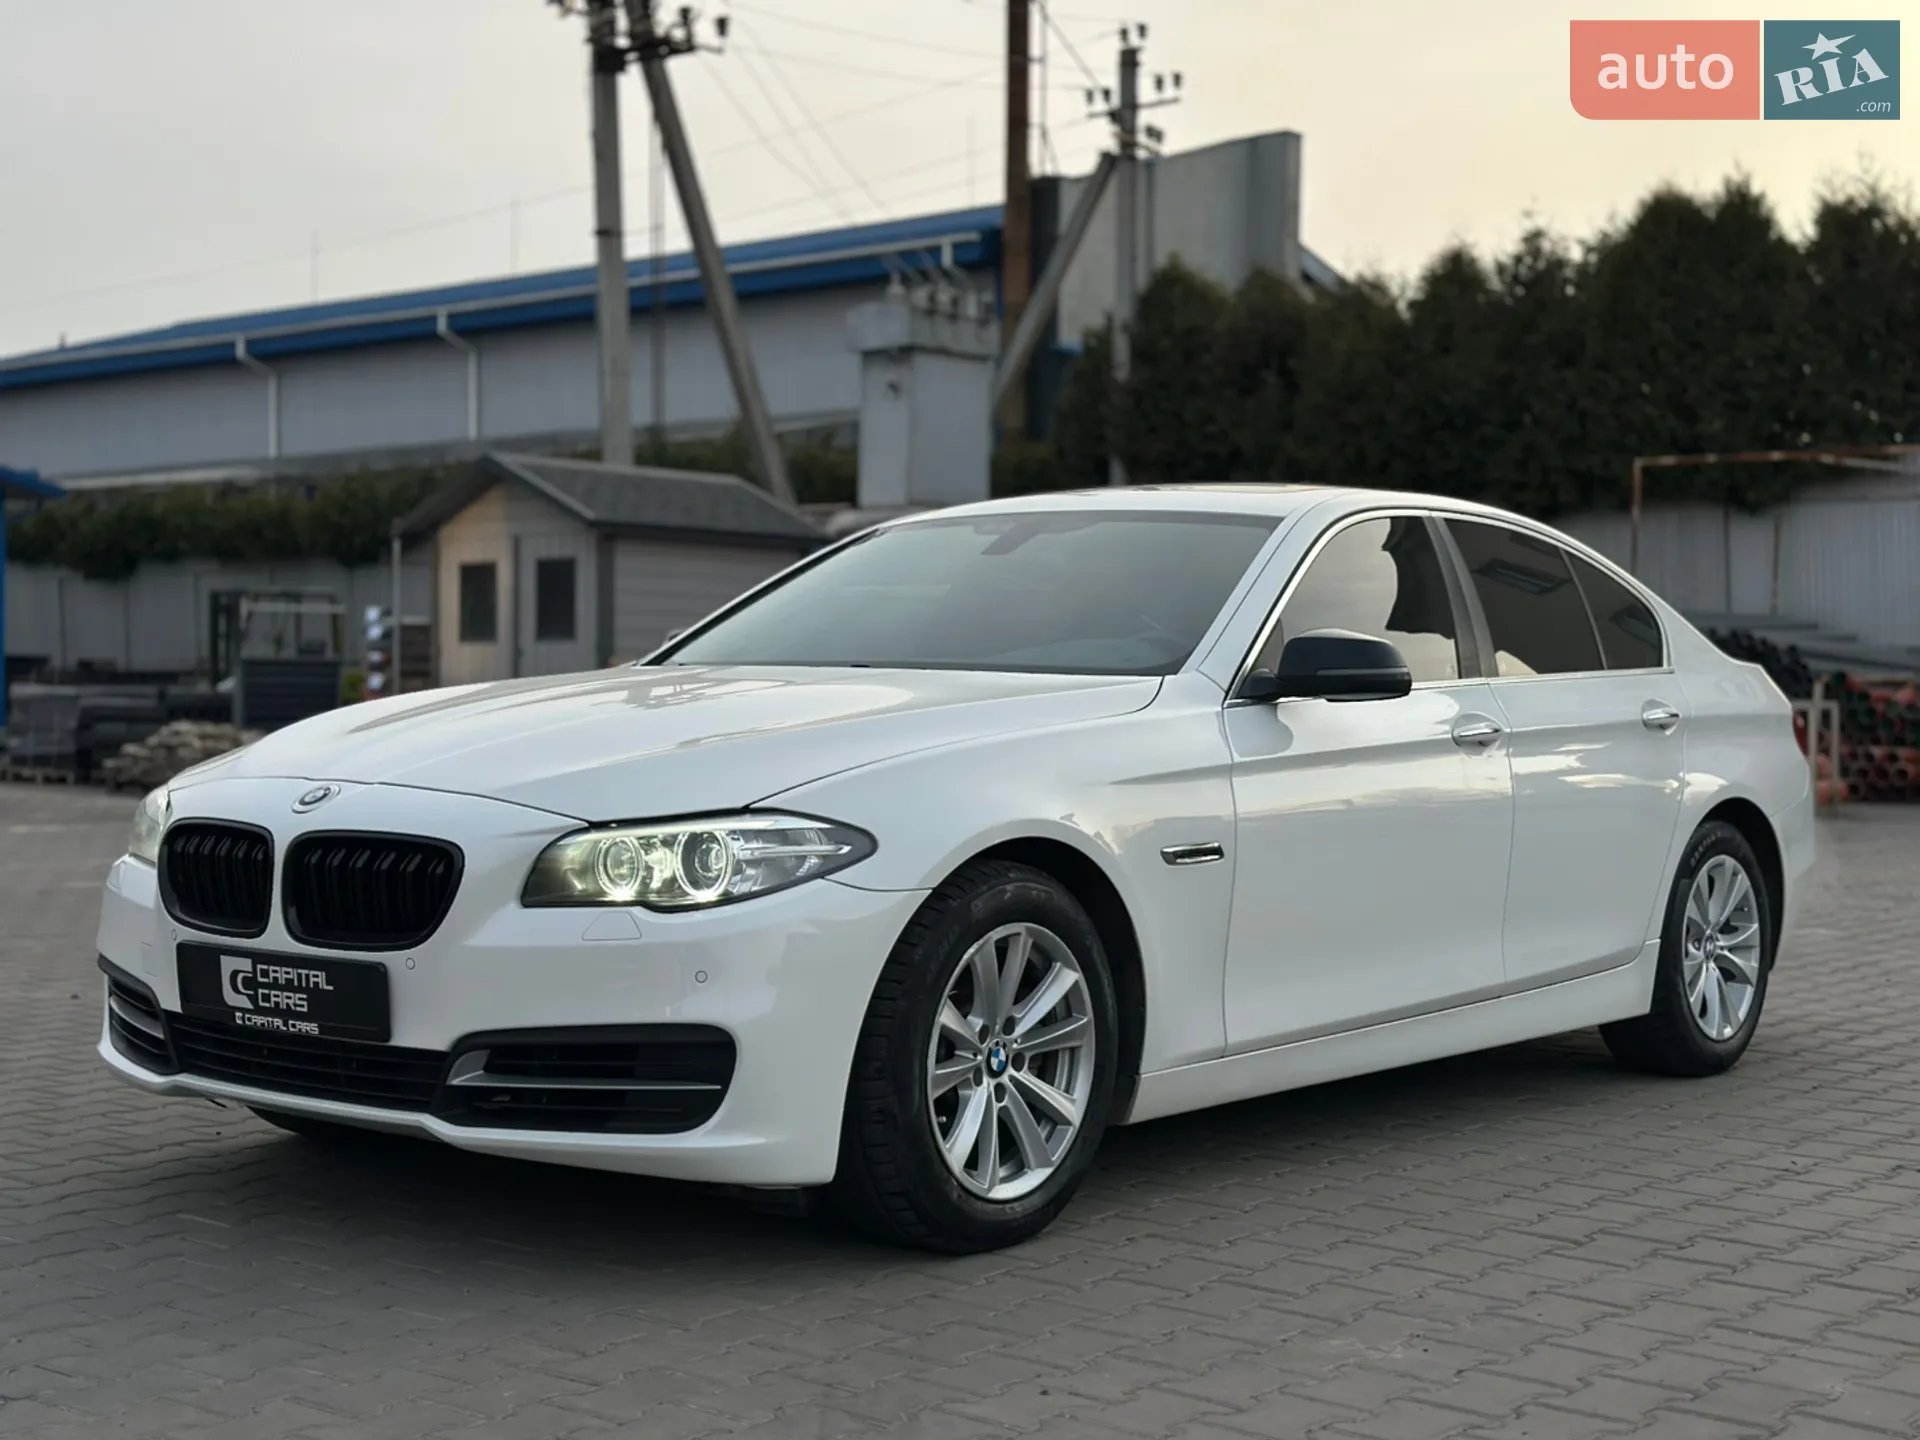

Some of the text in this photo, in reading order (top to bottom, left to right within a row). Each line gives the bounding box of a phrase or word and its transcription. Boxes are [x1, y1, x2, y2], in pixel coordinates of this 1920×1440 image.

[256, 963, 334, 991] CAPITAL
[258, 988, 308, 1012] CARS
[245, 1013, 287, 1031] CAPITAL
[288, 1020, 319, 1035] CARS
